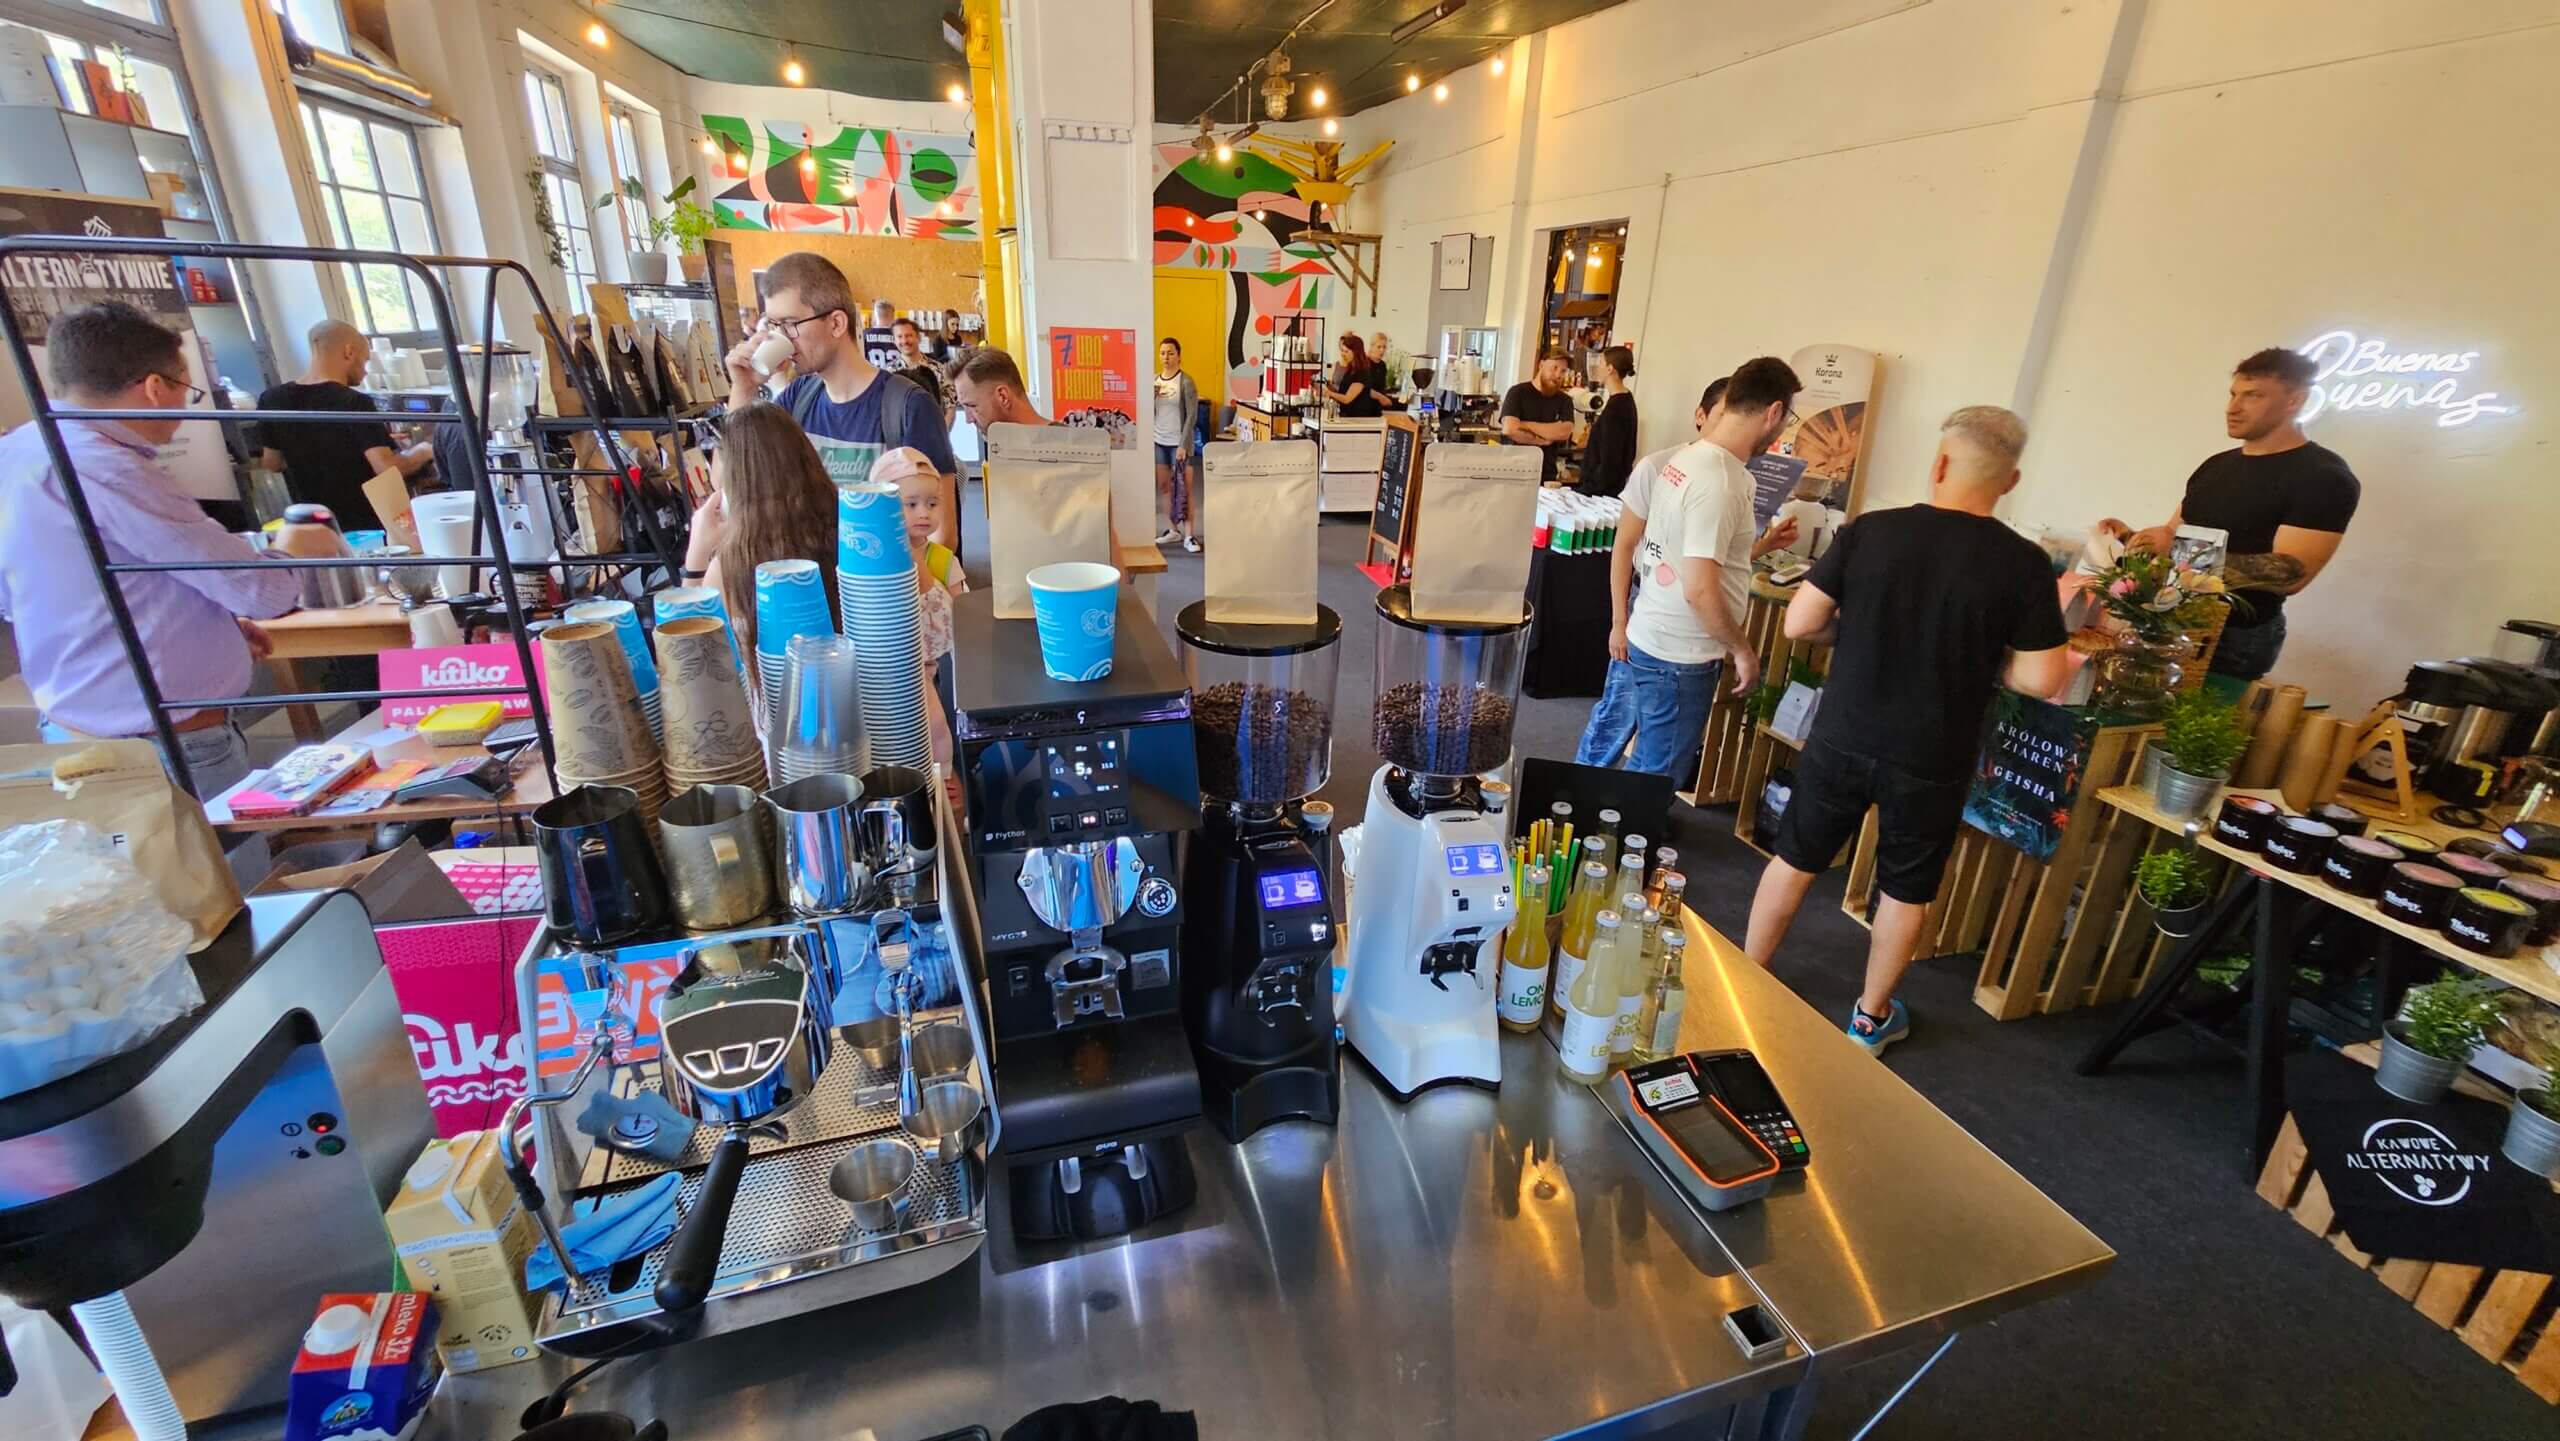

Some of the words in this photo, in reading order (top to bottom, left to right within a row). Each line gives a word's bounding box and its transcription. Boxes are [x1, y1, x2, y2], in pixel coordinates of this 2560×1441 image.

[1815, 367, 1843, 378] Korona
[2337, 340, 2480, 377] Buenas
[421, 657, 510, 688] kitiko
[1998, 721, 2079, 765] KRÓLOWA
[2002, 738, 2065, 774] ZIAREN
[1993, 766, 2056, 803] GEISHA
[2376, 1138, 2440, 1150] KAWOWE
[2346, 1153, 2490, 1172] ALTERNATYWY
[394, 1294, 416, 1336] mleko
